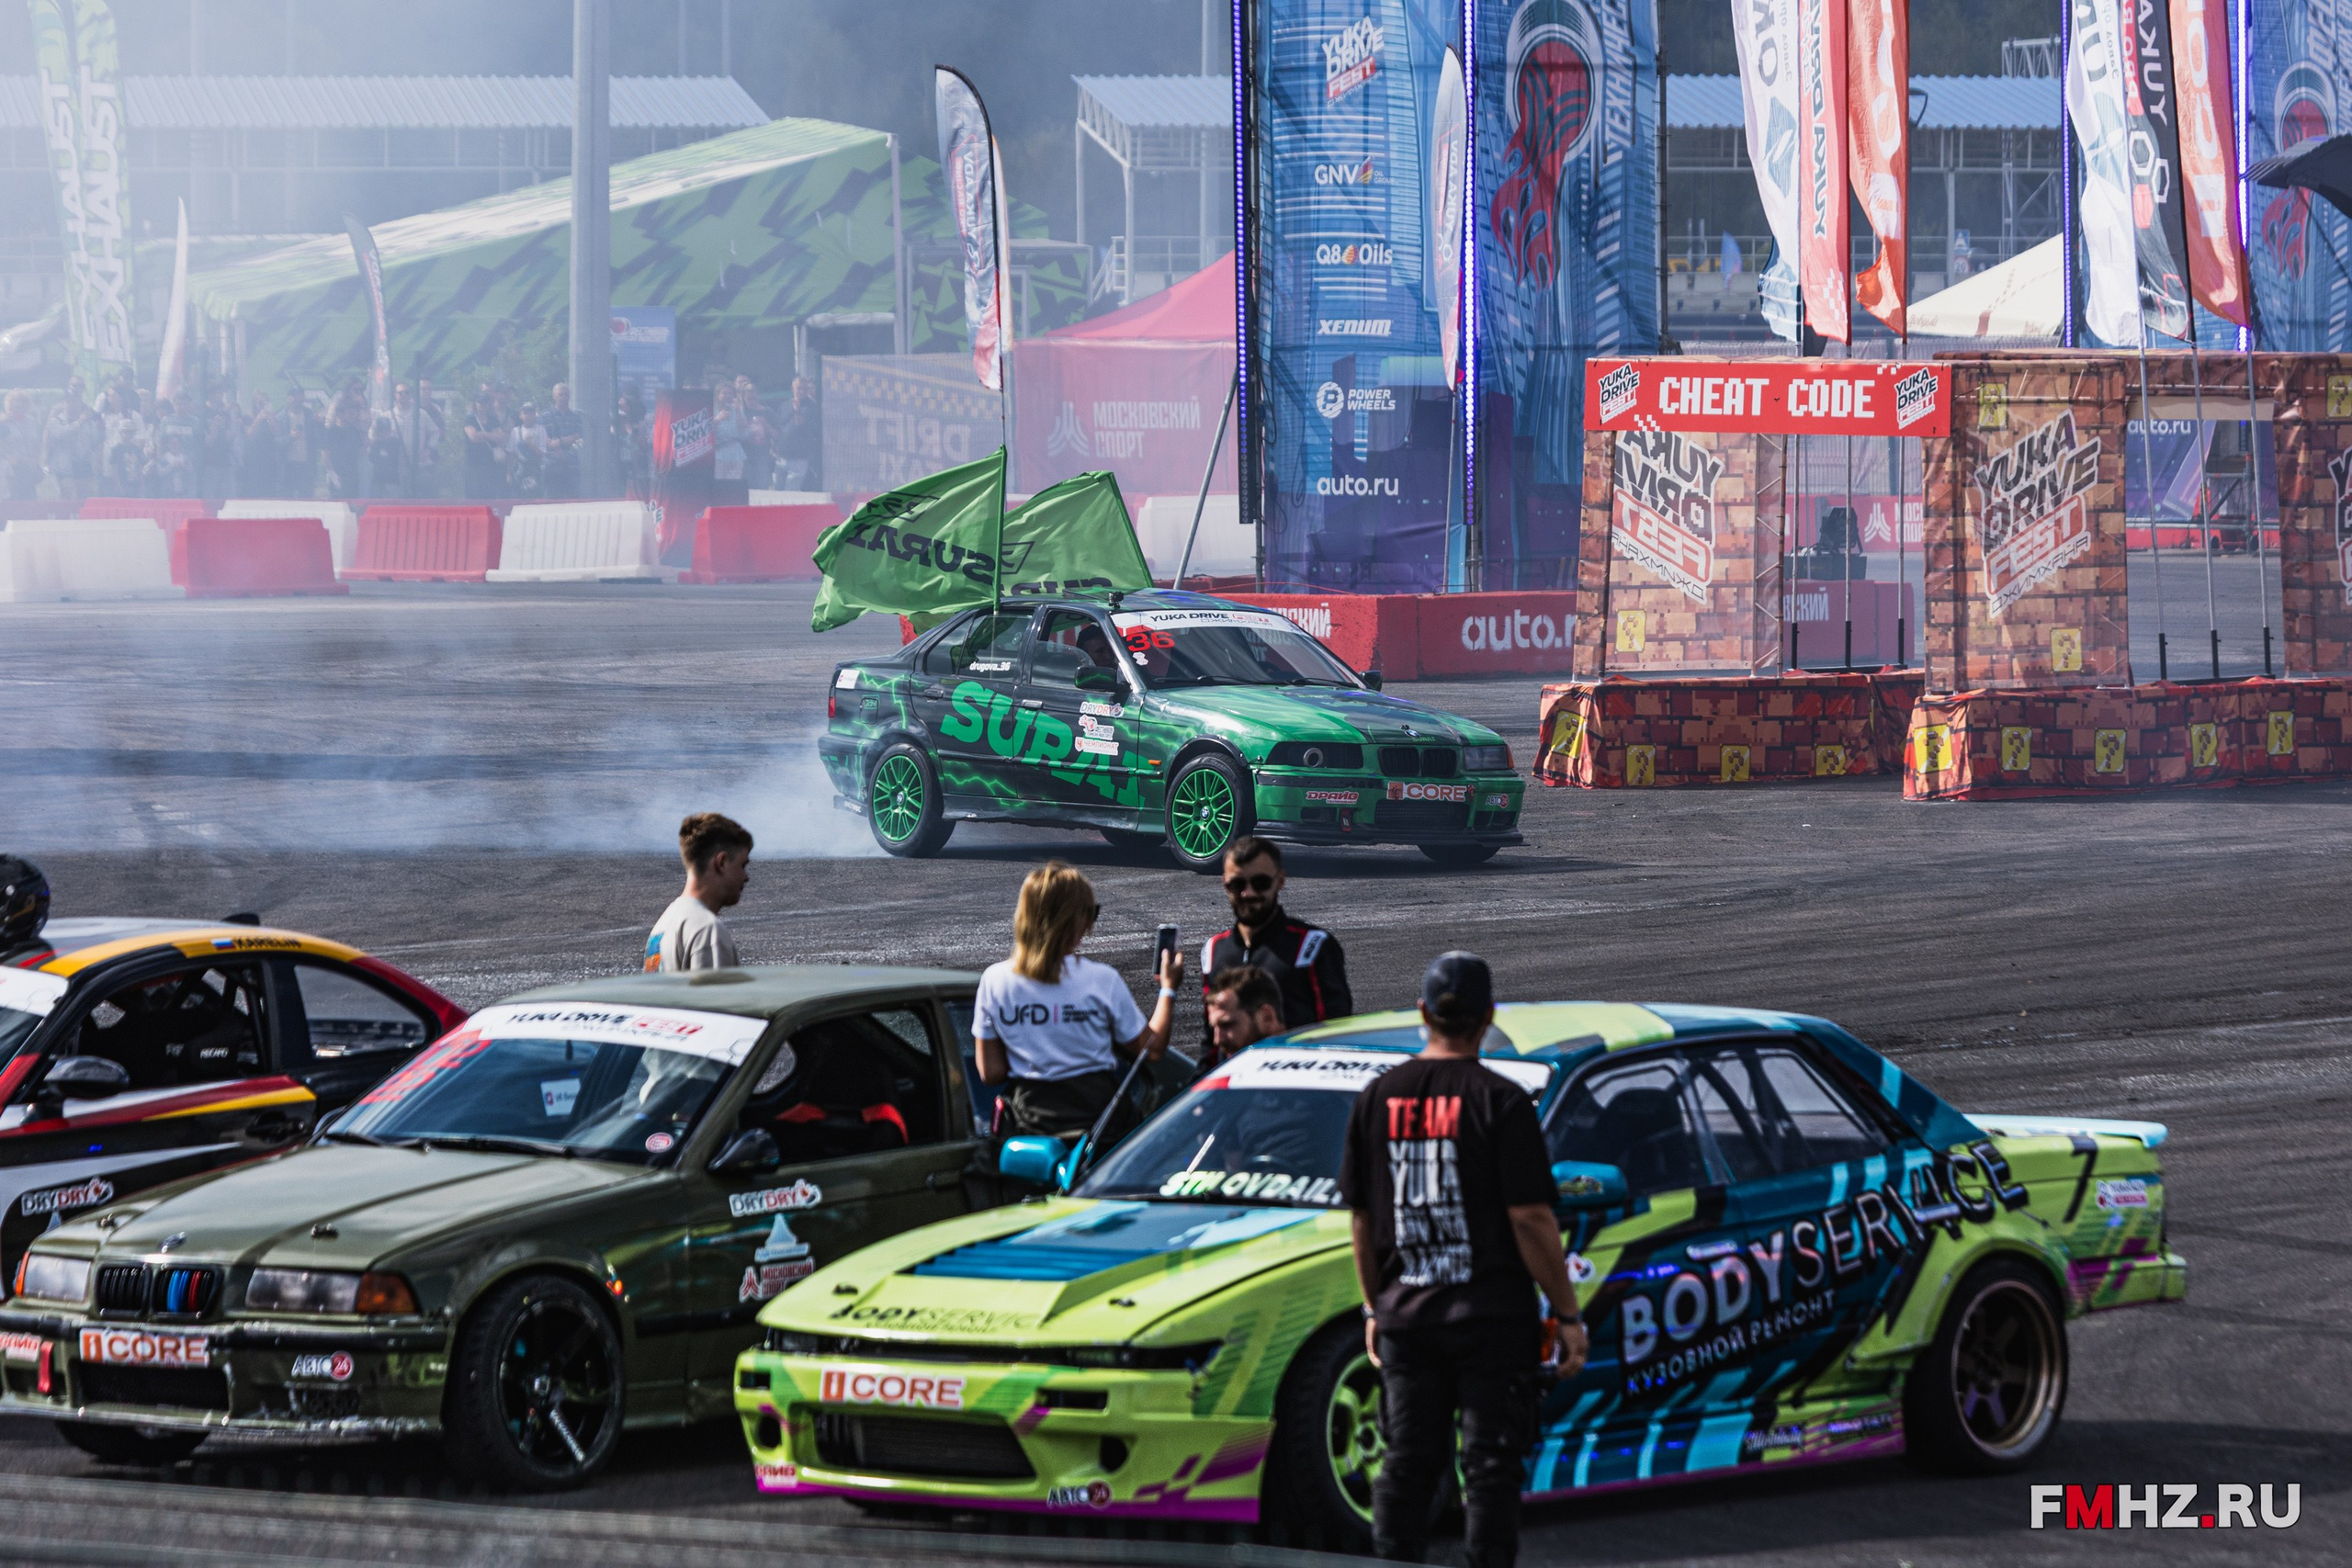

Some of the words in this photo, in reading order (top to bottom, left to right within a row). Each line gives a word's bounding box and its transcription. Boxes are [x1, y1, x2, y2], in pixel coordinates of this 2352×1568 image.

[1322, 16, 1374, 56] YUKA
[1327, 27, 1385, 81] DRIVE
[1329, 55, 1376, 98] FEST
[1315, 164, 1359, 185] GNV
[80, 64, 131, 362] EXHAUST
[1316, 243, 1341, 265] Q8
[1359, 243, 1393, 265] Oils
[1600, 364, 1632, 390] YUKA
[1601, 372, 1639, 403] DRIVE
[1895, 368, 1929, 395] YUKA
[1347, 400, 1396, 411] WHEELS
[1348, 389, 1391, 400] POWER
[1602, 389, 1634, 416] FEST
[1659, 377, 1769, 416] CHEAT
[1788, 379, 1875, 419] CODE
[1898, 378, 1937, 410] DRIVE
[1899, 394, 1933, 422] FEST
[672, 409, 708, 436] YUKA
[1093, 395, 1201, 429] МОСКОВСКИЙ
[673, 419, 715, 448] DRIVE
[1095, 431, 1145, 458] СПОРТ
[1976, 412, 2077, 506] YUKA
[1317, 474, 1399, 496] auto.ru
[1983, 441, 2098, 558] DRIVE
[1989, 500, 2079, 592] FEST
[1150, 613, 1187, 622] YUKA
[1189, 612, 1229, 620] DRIVE
[1126, 631, 1175, 652] 36
[940, 681, 1158, 812] SURAI
[1084, 740, 1118, 750] ЧЕМПИОНАТ
[1387, 1095, 1462, 1140] TEAM
[1390, 1160, 1464, 1208] YUKA
[2062, 1135, 2099, 1224] 7
